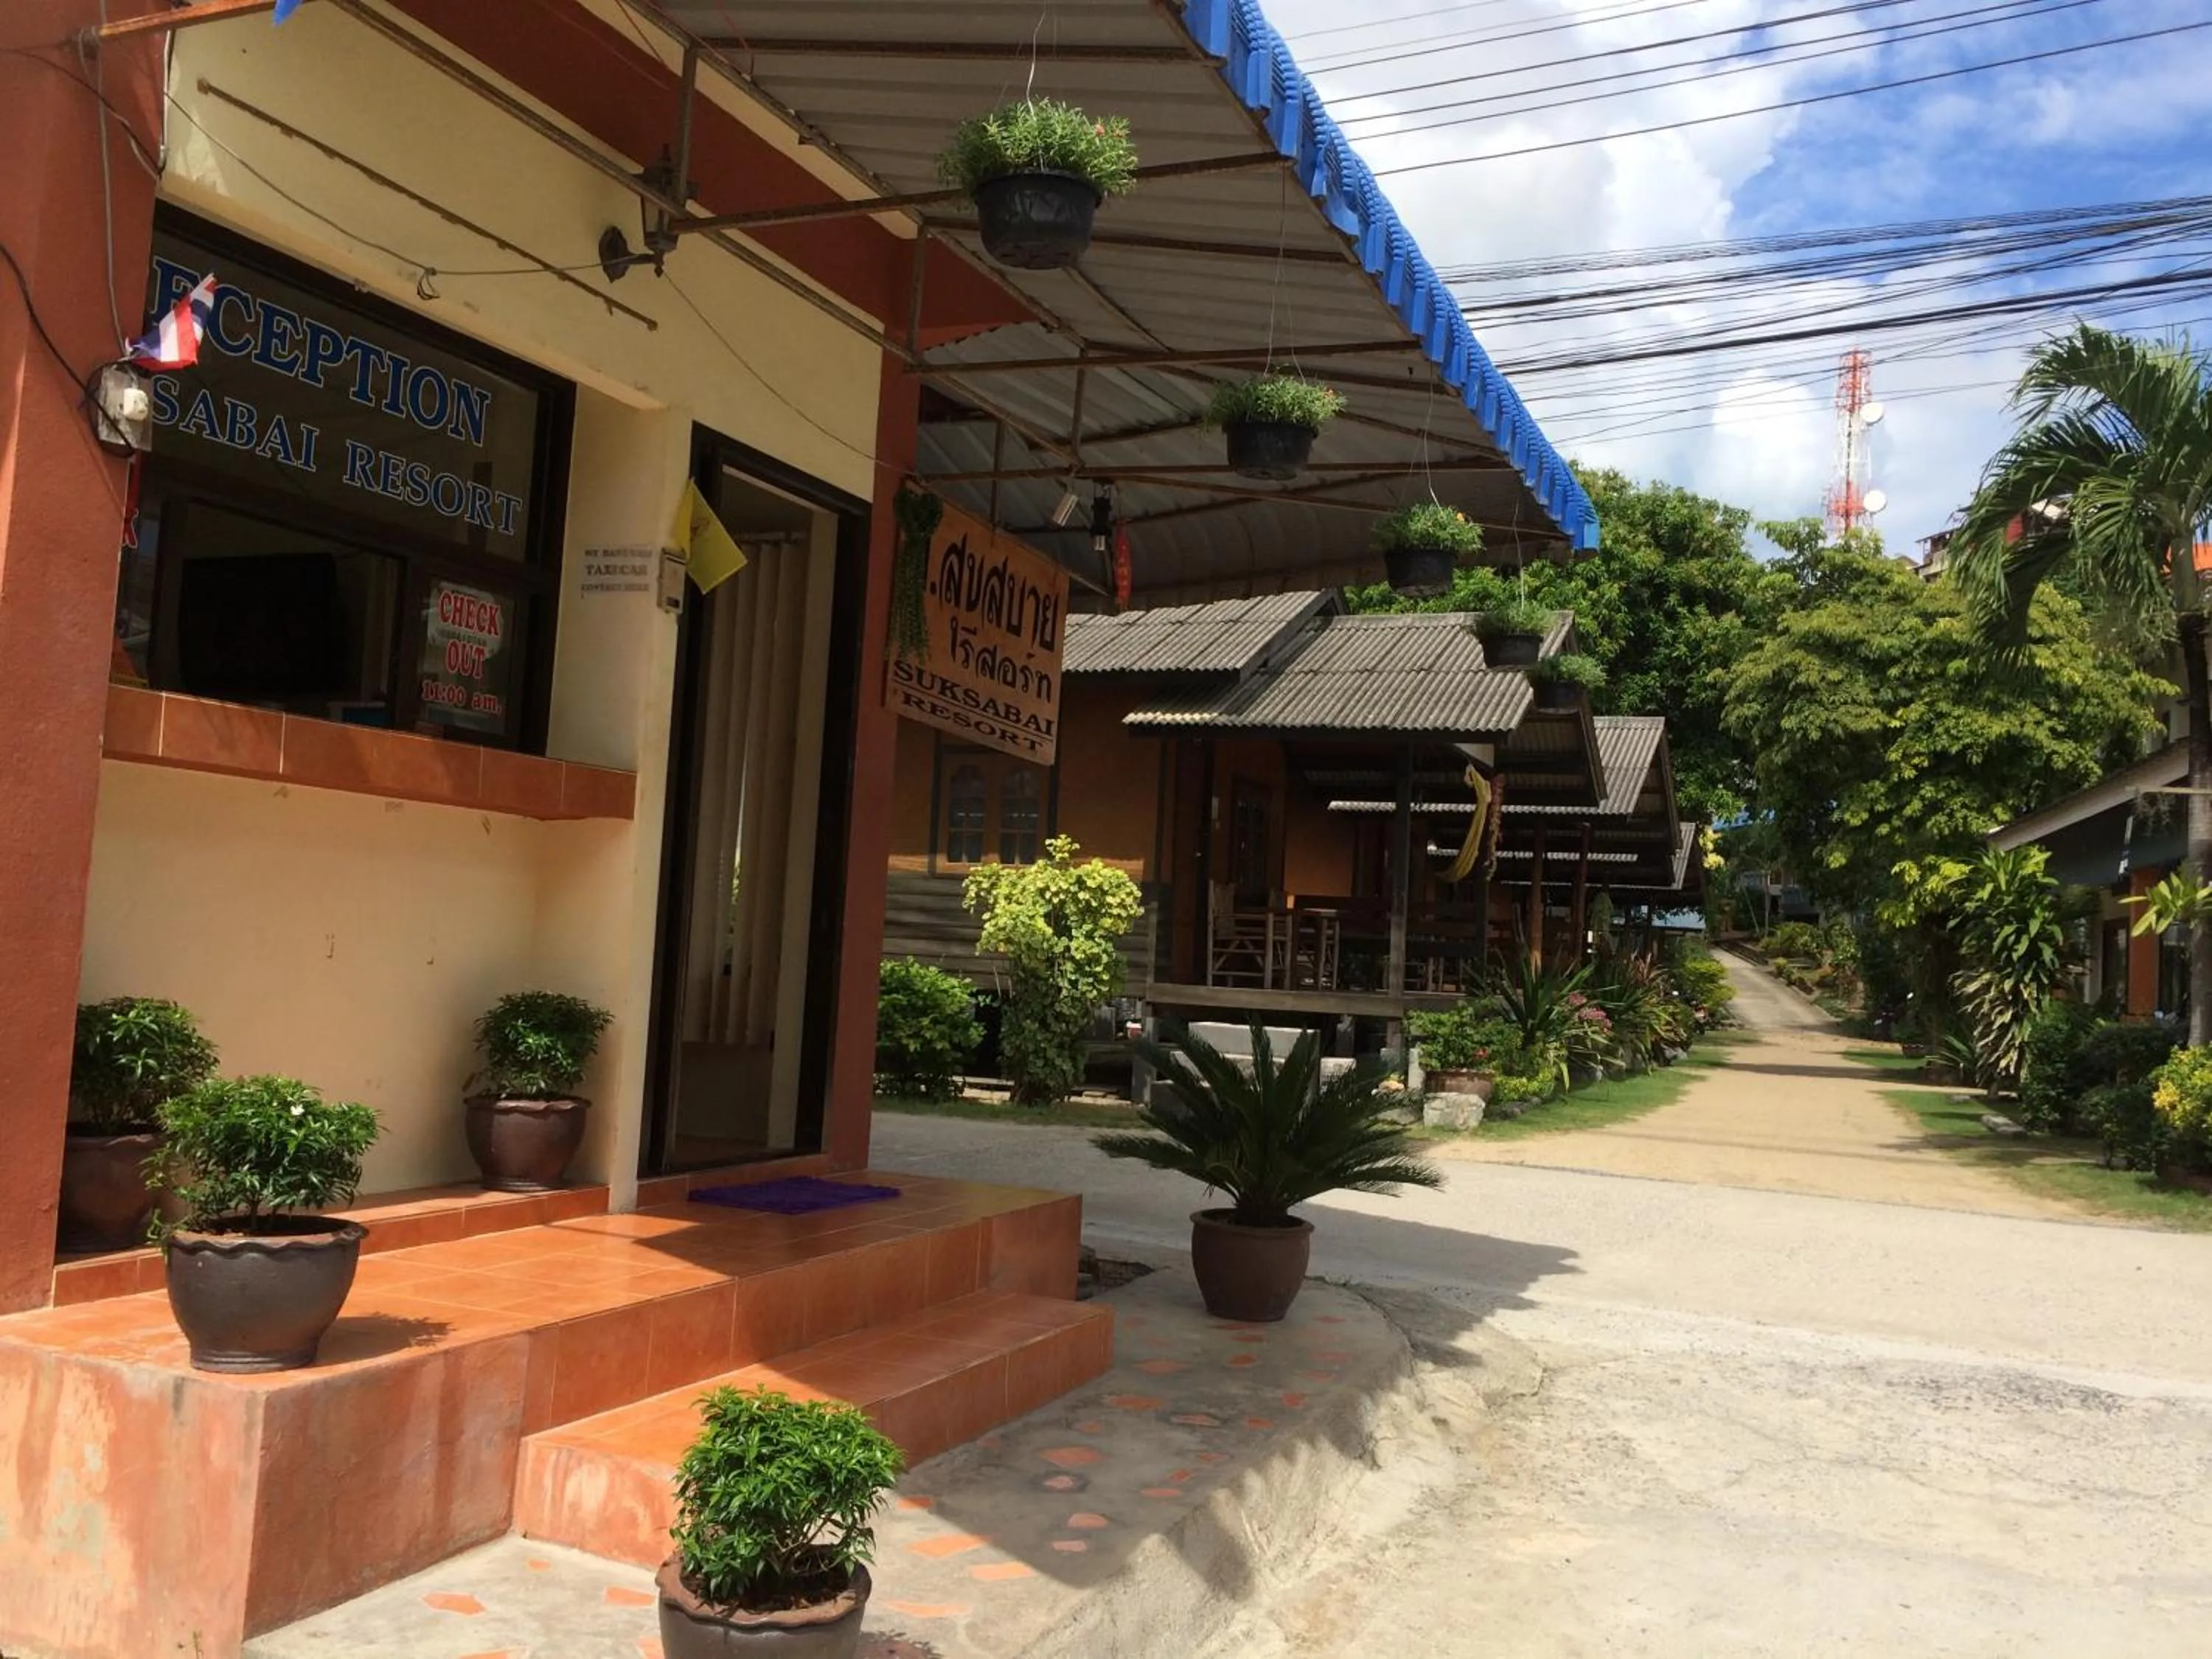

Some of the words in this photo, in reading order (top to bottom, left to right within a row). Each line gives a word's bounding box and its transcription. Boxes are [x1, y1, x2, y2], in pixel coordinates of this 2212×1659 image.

[152, 375, 319, 471] SABAI
[344, 439, 523, 535] RESORT
[438, 591, 501, 638] CHECK
[446, 639, 486, 679] OUT
[893, 659, 1055, 737] SUKSABAI
[900, 689, 1045, 752] RESORT
